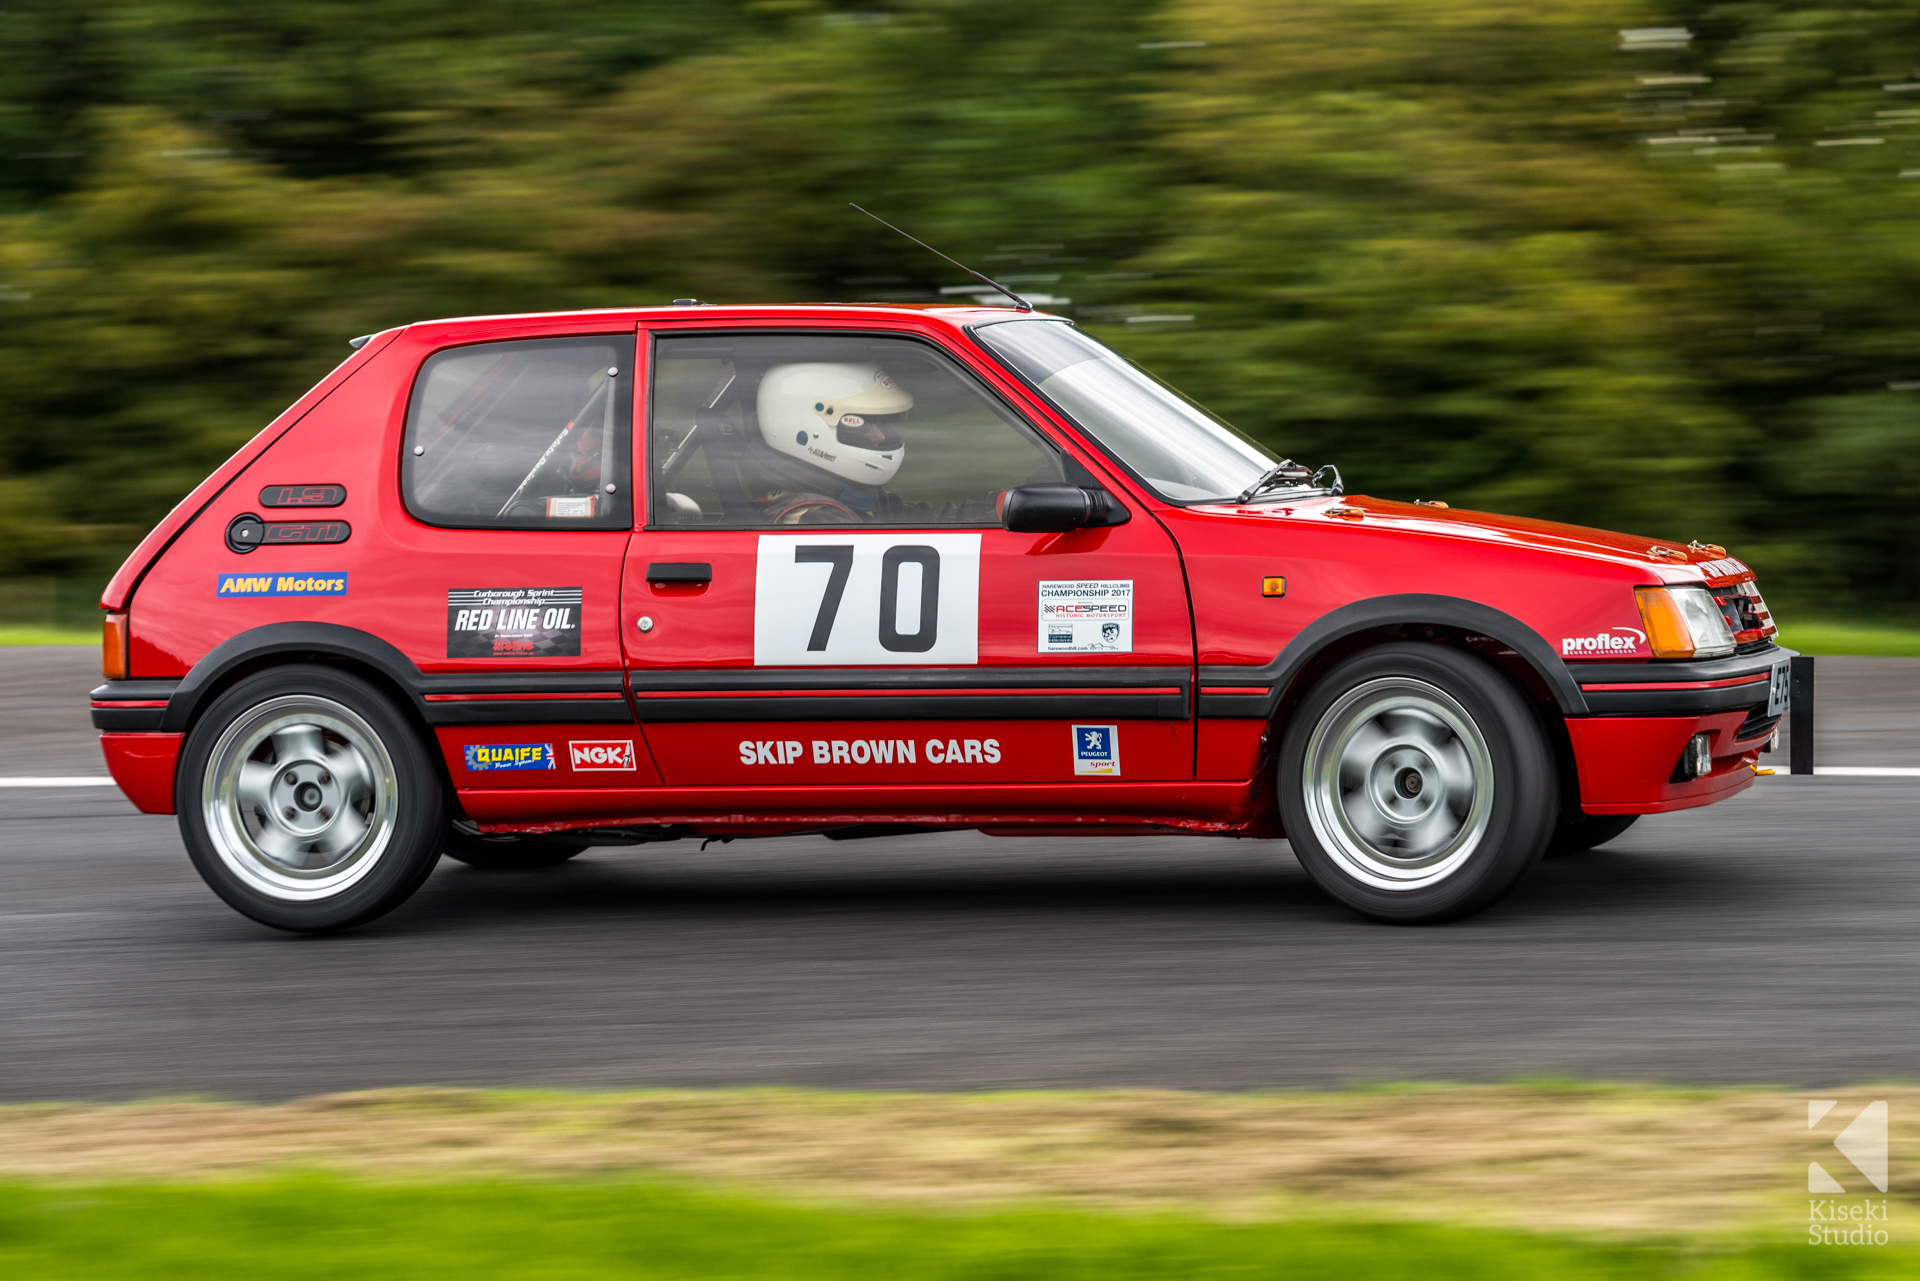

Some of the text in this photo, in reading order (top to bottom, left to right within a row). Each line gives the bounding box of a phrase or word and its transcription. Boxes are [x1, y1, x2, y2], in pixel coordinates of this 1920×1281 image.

[266, 524, 342, 541] GTI
[220, 577, 345, 593] AMW Motors
[473, 589, 555, 598] Curborough Sprint
[1041, 589, 1131, 597] CHAMPIONSHIP 2017
[482, 597, 546, 606] Championship
[794, 544, 941, 653] 70
[1056, 604, 1127, 613] ACESPEED
[454, 607, 576, 631] RED LINE OIL.
[492, 638, 535, 652] lifeline
[1562, 633, 1636, 655] proflex
[477, 746, 543, 763] QUAIFE
[573, 747, 624, 764] NGK
[738, 738, 1002, 765] SKIP BROWN CARS
